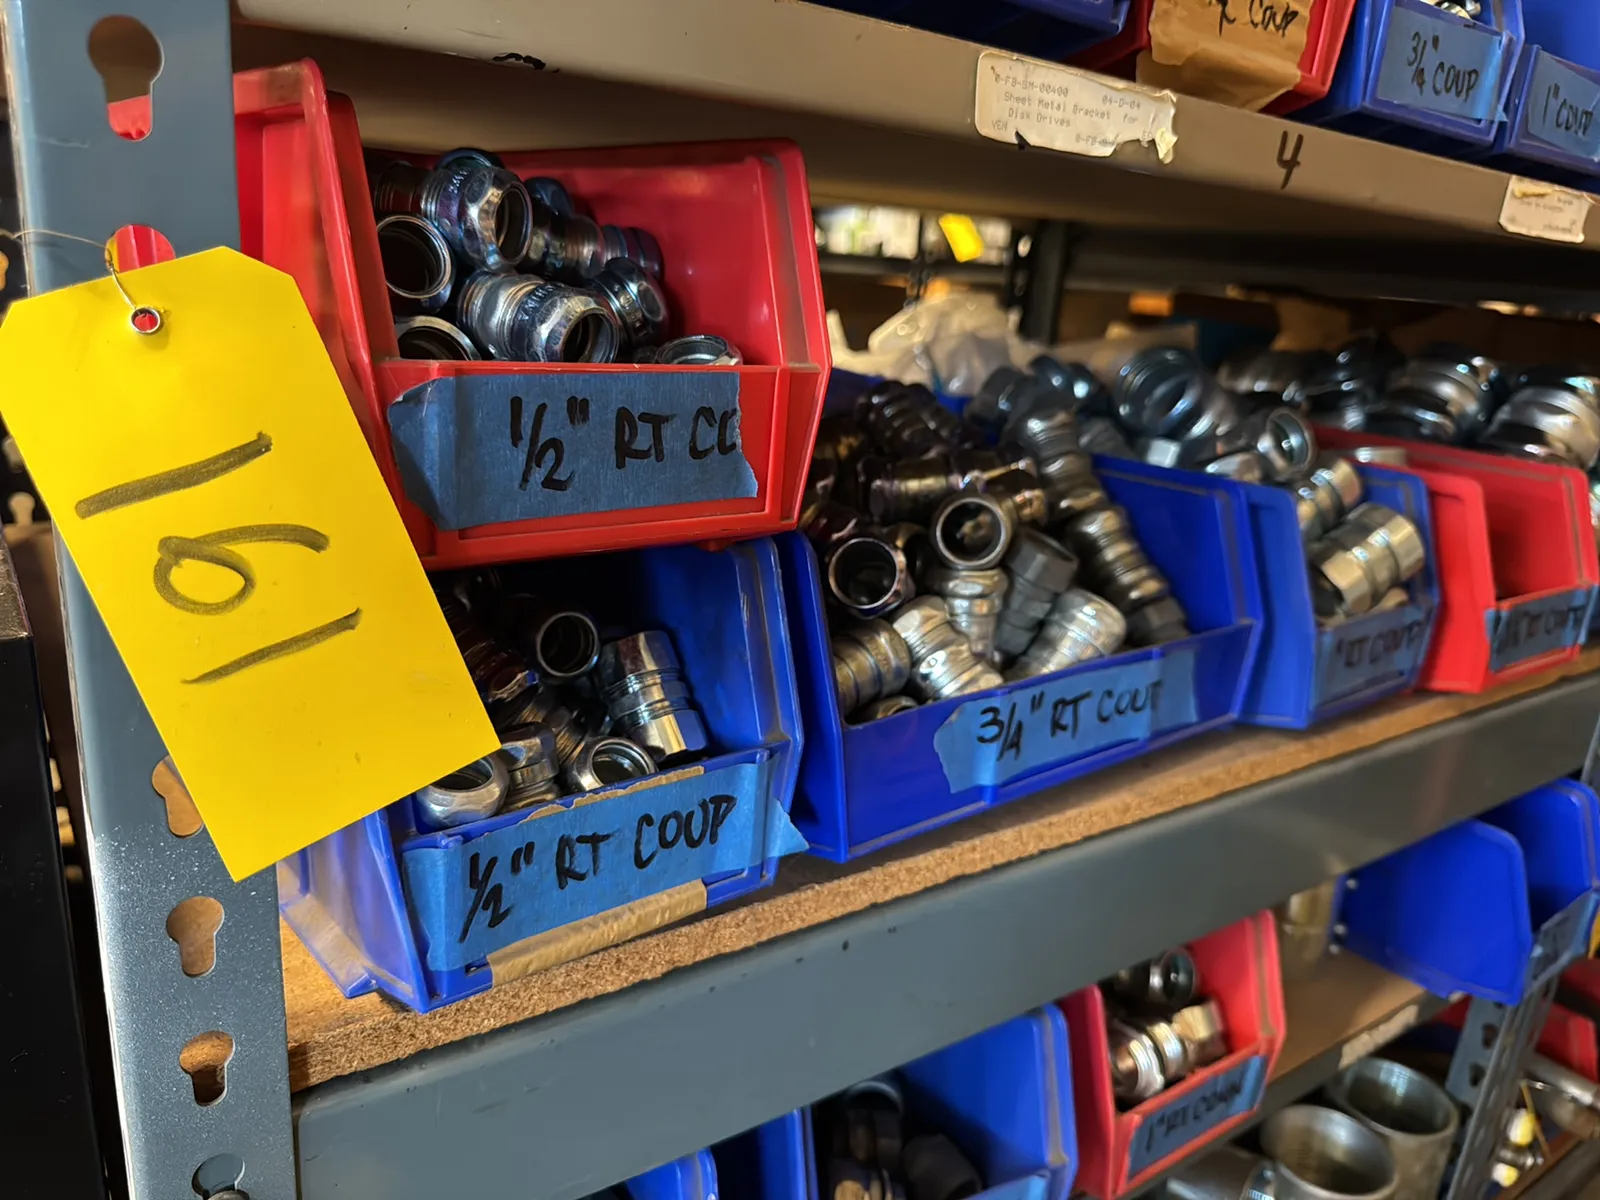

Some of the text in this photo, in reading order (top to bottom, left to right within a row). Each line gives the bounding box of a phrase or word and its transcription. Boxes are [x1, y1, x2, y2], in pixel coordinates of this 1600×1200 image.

[1004, 90, 1139, 124] Sheet Metal Bracket for
[1432, 61, 1479, 103] COUP
[1008, 106, 1071, 128] Disk Drives
[1276, 130, 1304, 190] 4
[614, 406, 677, 470] RT
[1050, 690, 1094, 740] RT
[555, 828, 620, 890] RT
[633, 794, 738, 870] COUP
